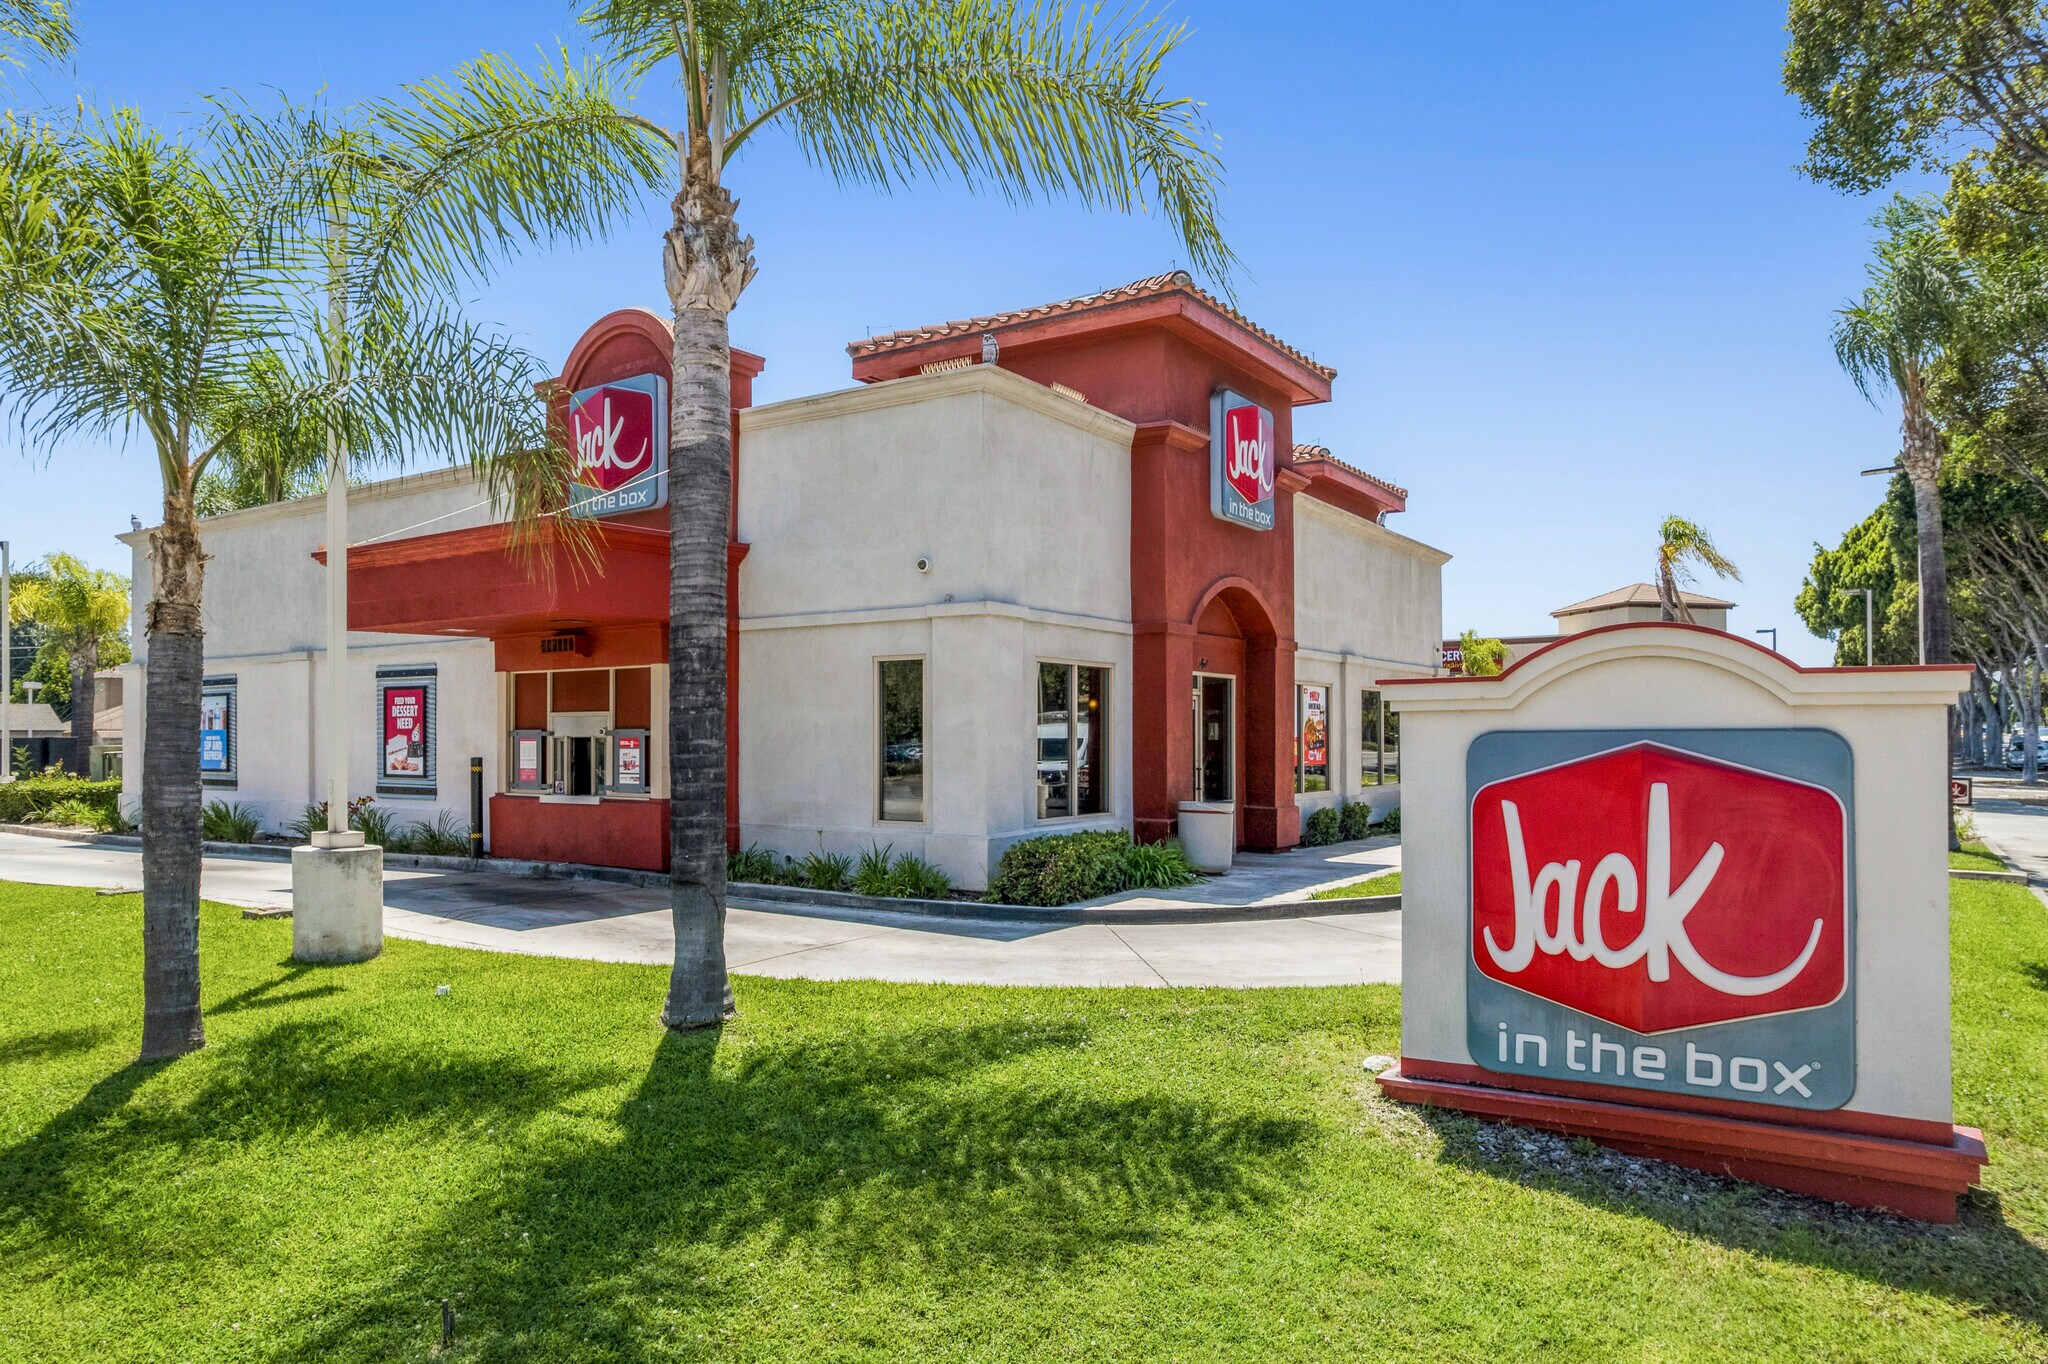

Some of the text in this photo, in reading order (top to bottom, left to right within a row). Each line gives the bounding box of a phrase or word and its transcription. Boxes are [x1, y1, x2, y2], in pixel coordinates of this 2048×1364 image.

[572, 397, 648, 478] Jack
[1229, 415, 1274, 492] Jack
[592, 496, 616, 511] the
[619, 490, 648, 507] box
[1229, 498, 1272, 525] in the box
[392, 705, 418, 717] DESSERT
[397, 718, 413, 729] NEED
[1483, 782, 1824, 996] Jack
[1498, 1021, 1548, 1067] in
[1566, 1029, 1667, 1081] the
